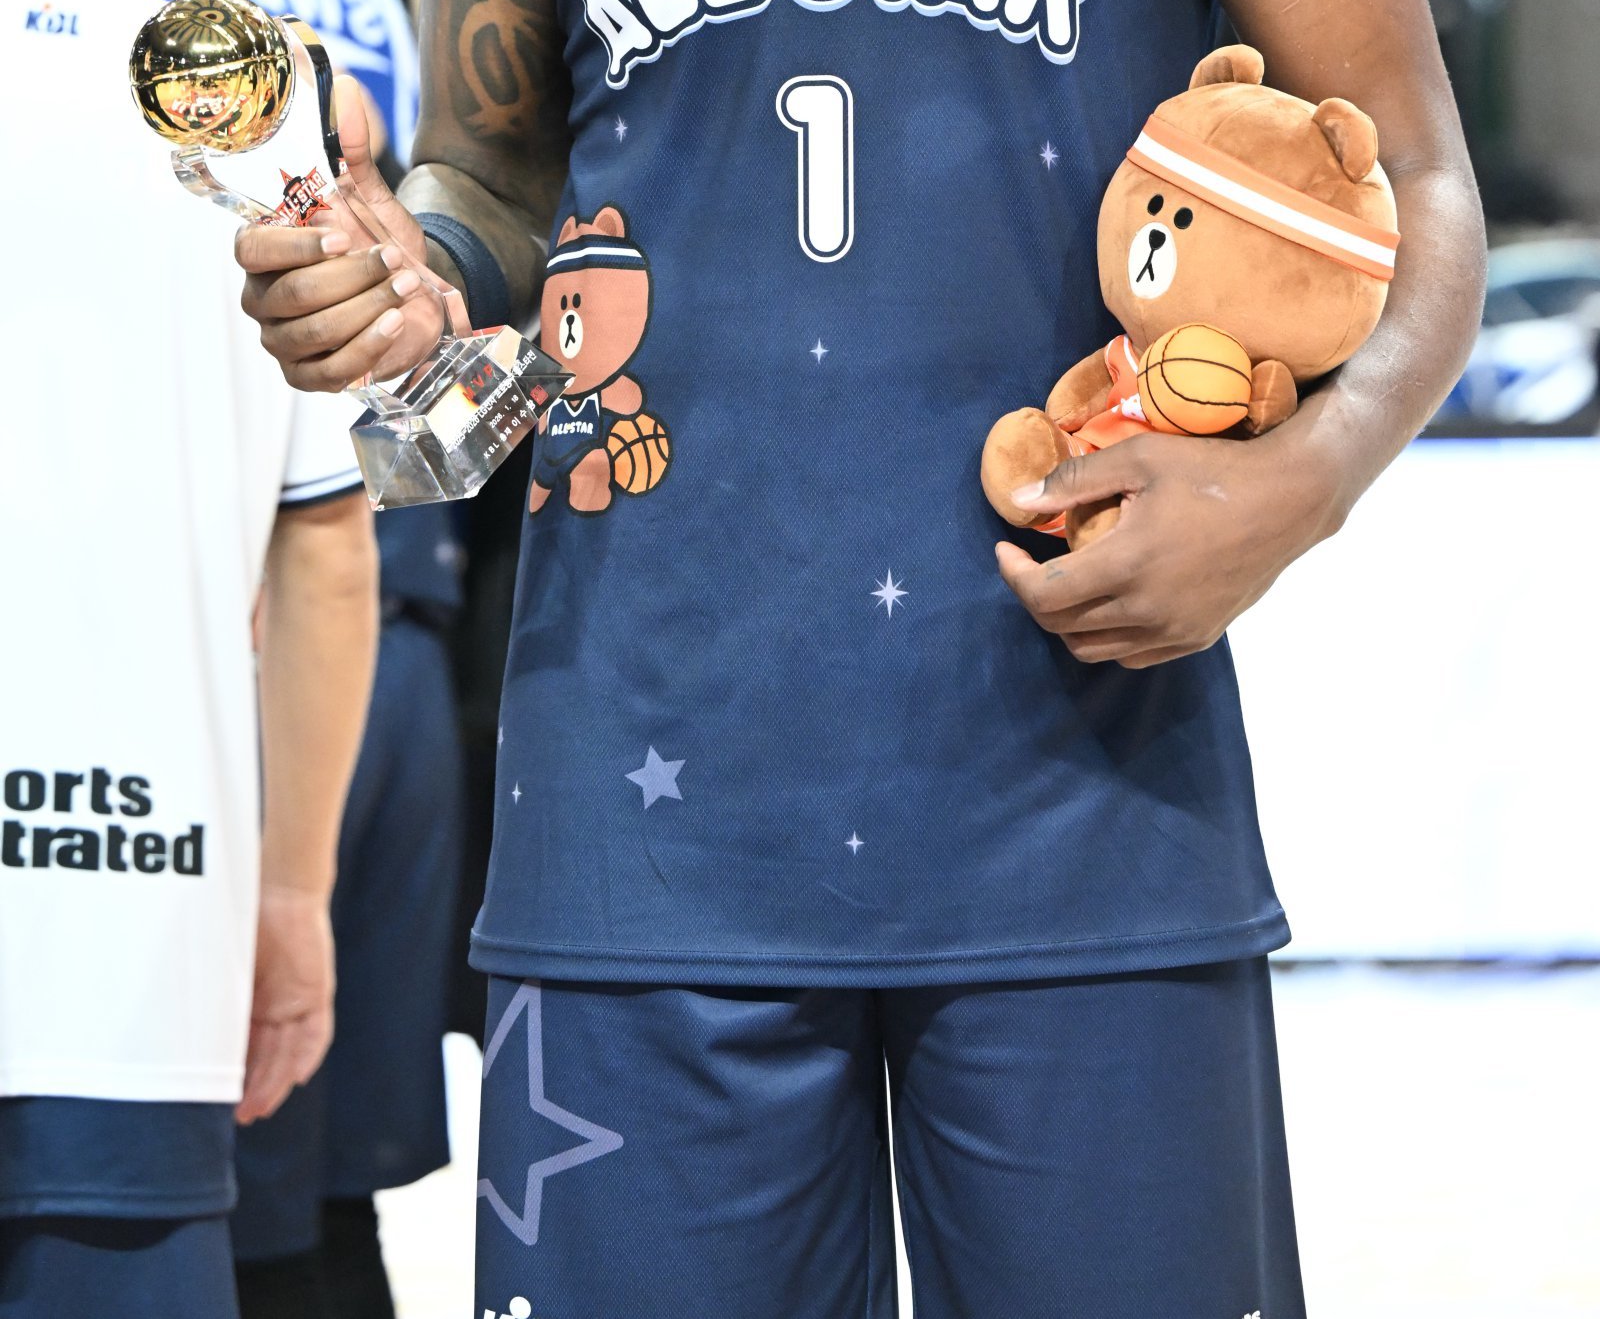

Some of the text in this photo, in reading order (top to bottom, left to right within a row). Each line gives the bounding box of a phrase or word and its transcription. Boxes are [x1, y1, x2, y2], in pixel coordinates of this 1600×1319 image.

[295, 171, 327, 204] STAR
[776, 74, 854, 263] 1
[551, 420, 594, 437] ALL STAR
[483, 442, 501, 460] KBL
[4, 766, 153, 818] orts
[1, 819, 204, 876] trated
